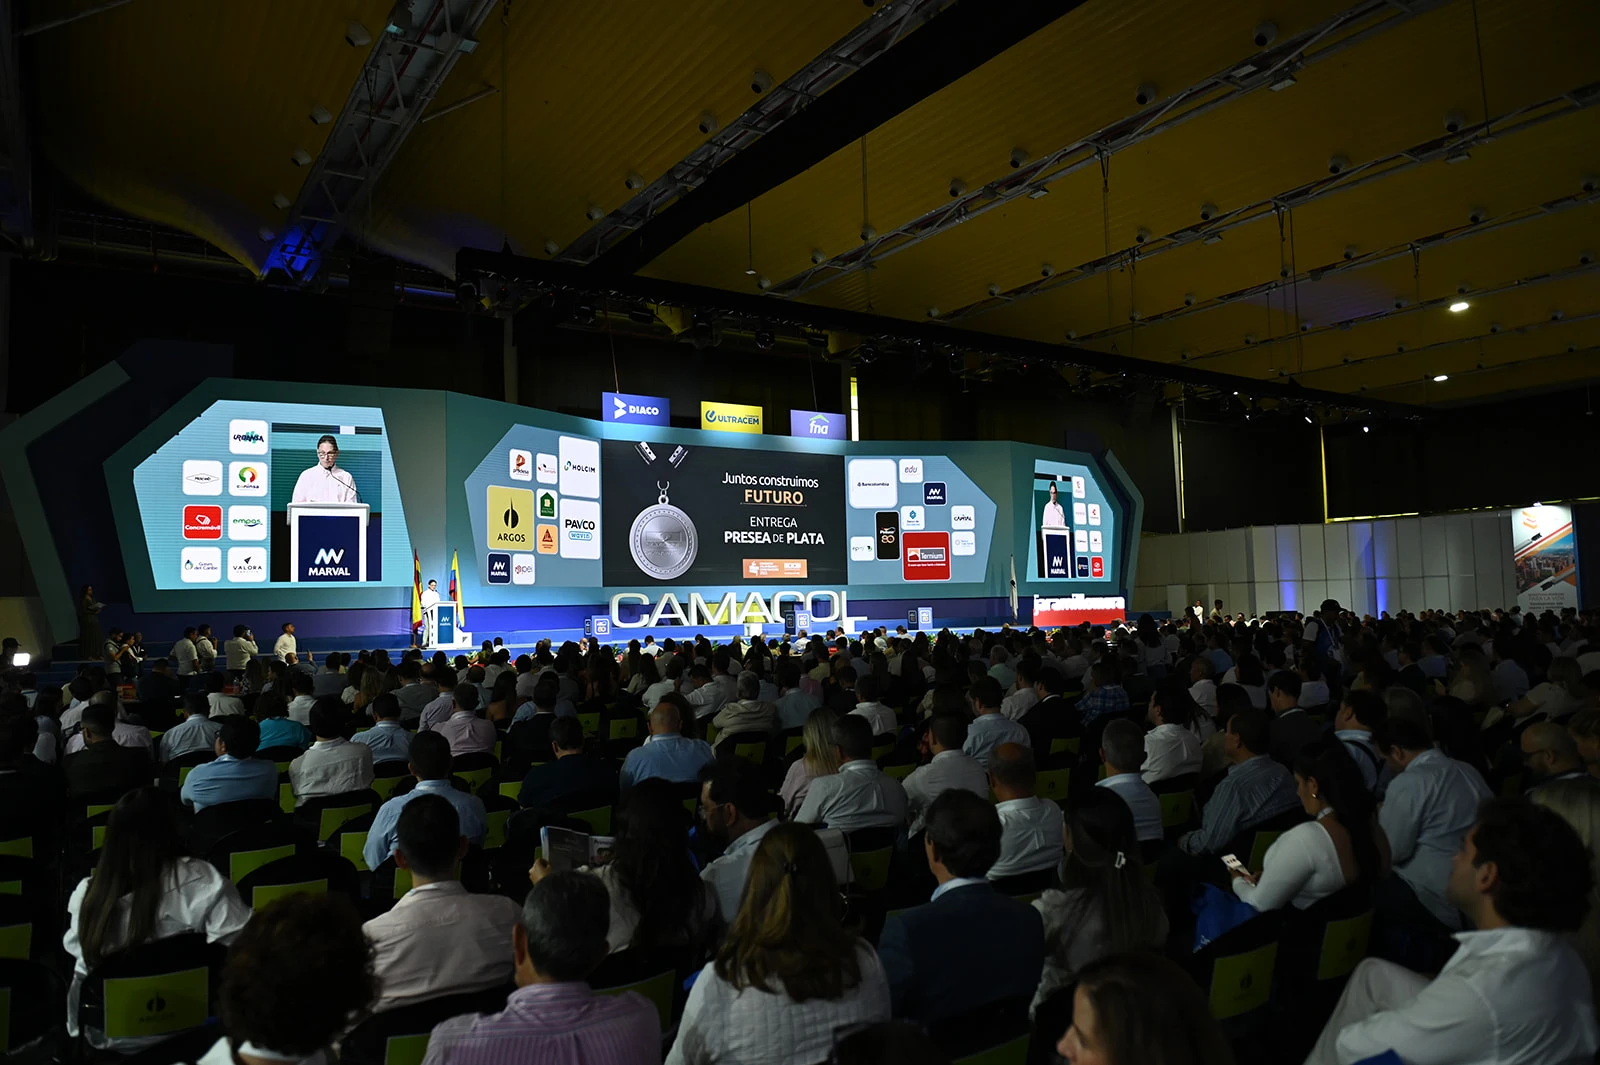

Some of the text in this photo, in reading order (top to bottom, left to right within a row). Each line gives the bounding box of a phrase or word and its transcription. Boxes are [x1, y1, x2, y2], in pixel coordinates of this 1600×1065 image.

[629, 405, 659, 416] DIACO
[718, 414, 759, 425] ULTRACEM
[809, 420, 828, 434] fna
[572, 464, 595, 473] HOLCIM
[904, 465, 917, 473] edu
[722, 472, 819, 488] Juntos construimos
[745, 489, 803, 504] FUTURO
[565, 519, 595, 530] PAVCO
[750, 517, 797, 528] ENTREGA
[497, 533, 525, 542] ARGOS
[724, 531, 824, 544] PRESEA DE PLATA
[308, 567, 350, 576] MARVAL
[609, 590, 867, 628] CAMACOL
